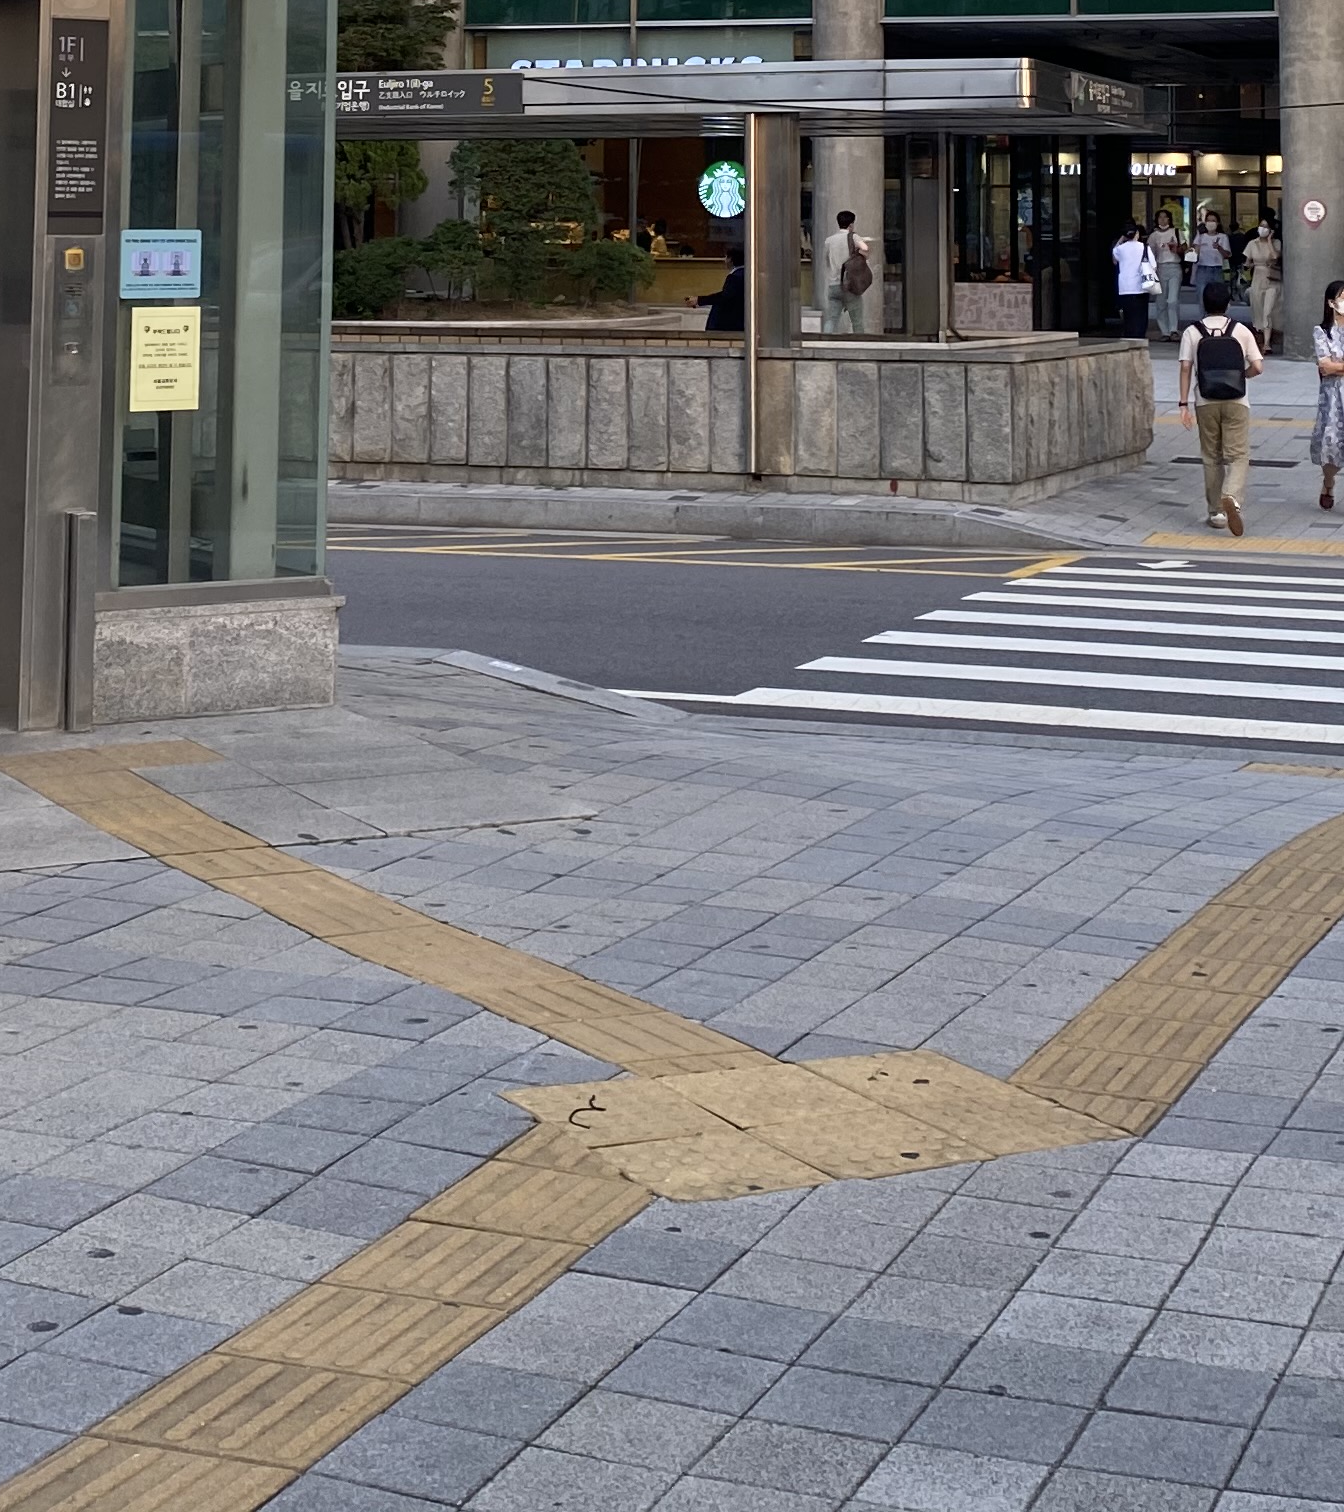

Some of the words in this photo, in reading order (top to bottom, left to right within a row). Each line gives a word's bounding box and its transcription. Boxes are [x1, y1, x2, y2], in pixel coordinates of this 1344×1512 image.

[58, 36, 77, 53] 1F
[56, 81, 76, 99] B1
[287, 79, 371, 102] 을지입구
[482, 77, 494, 95] 5
[1131, 162, 1177, 176] OUNG
